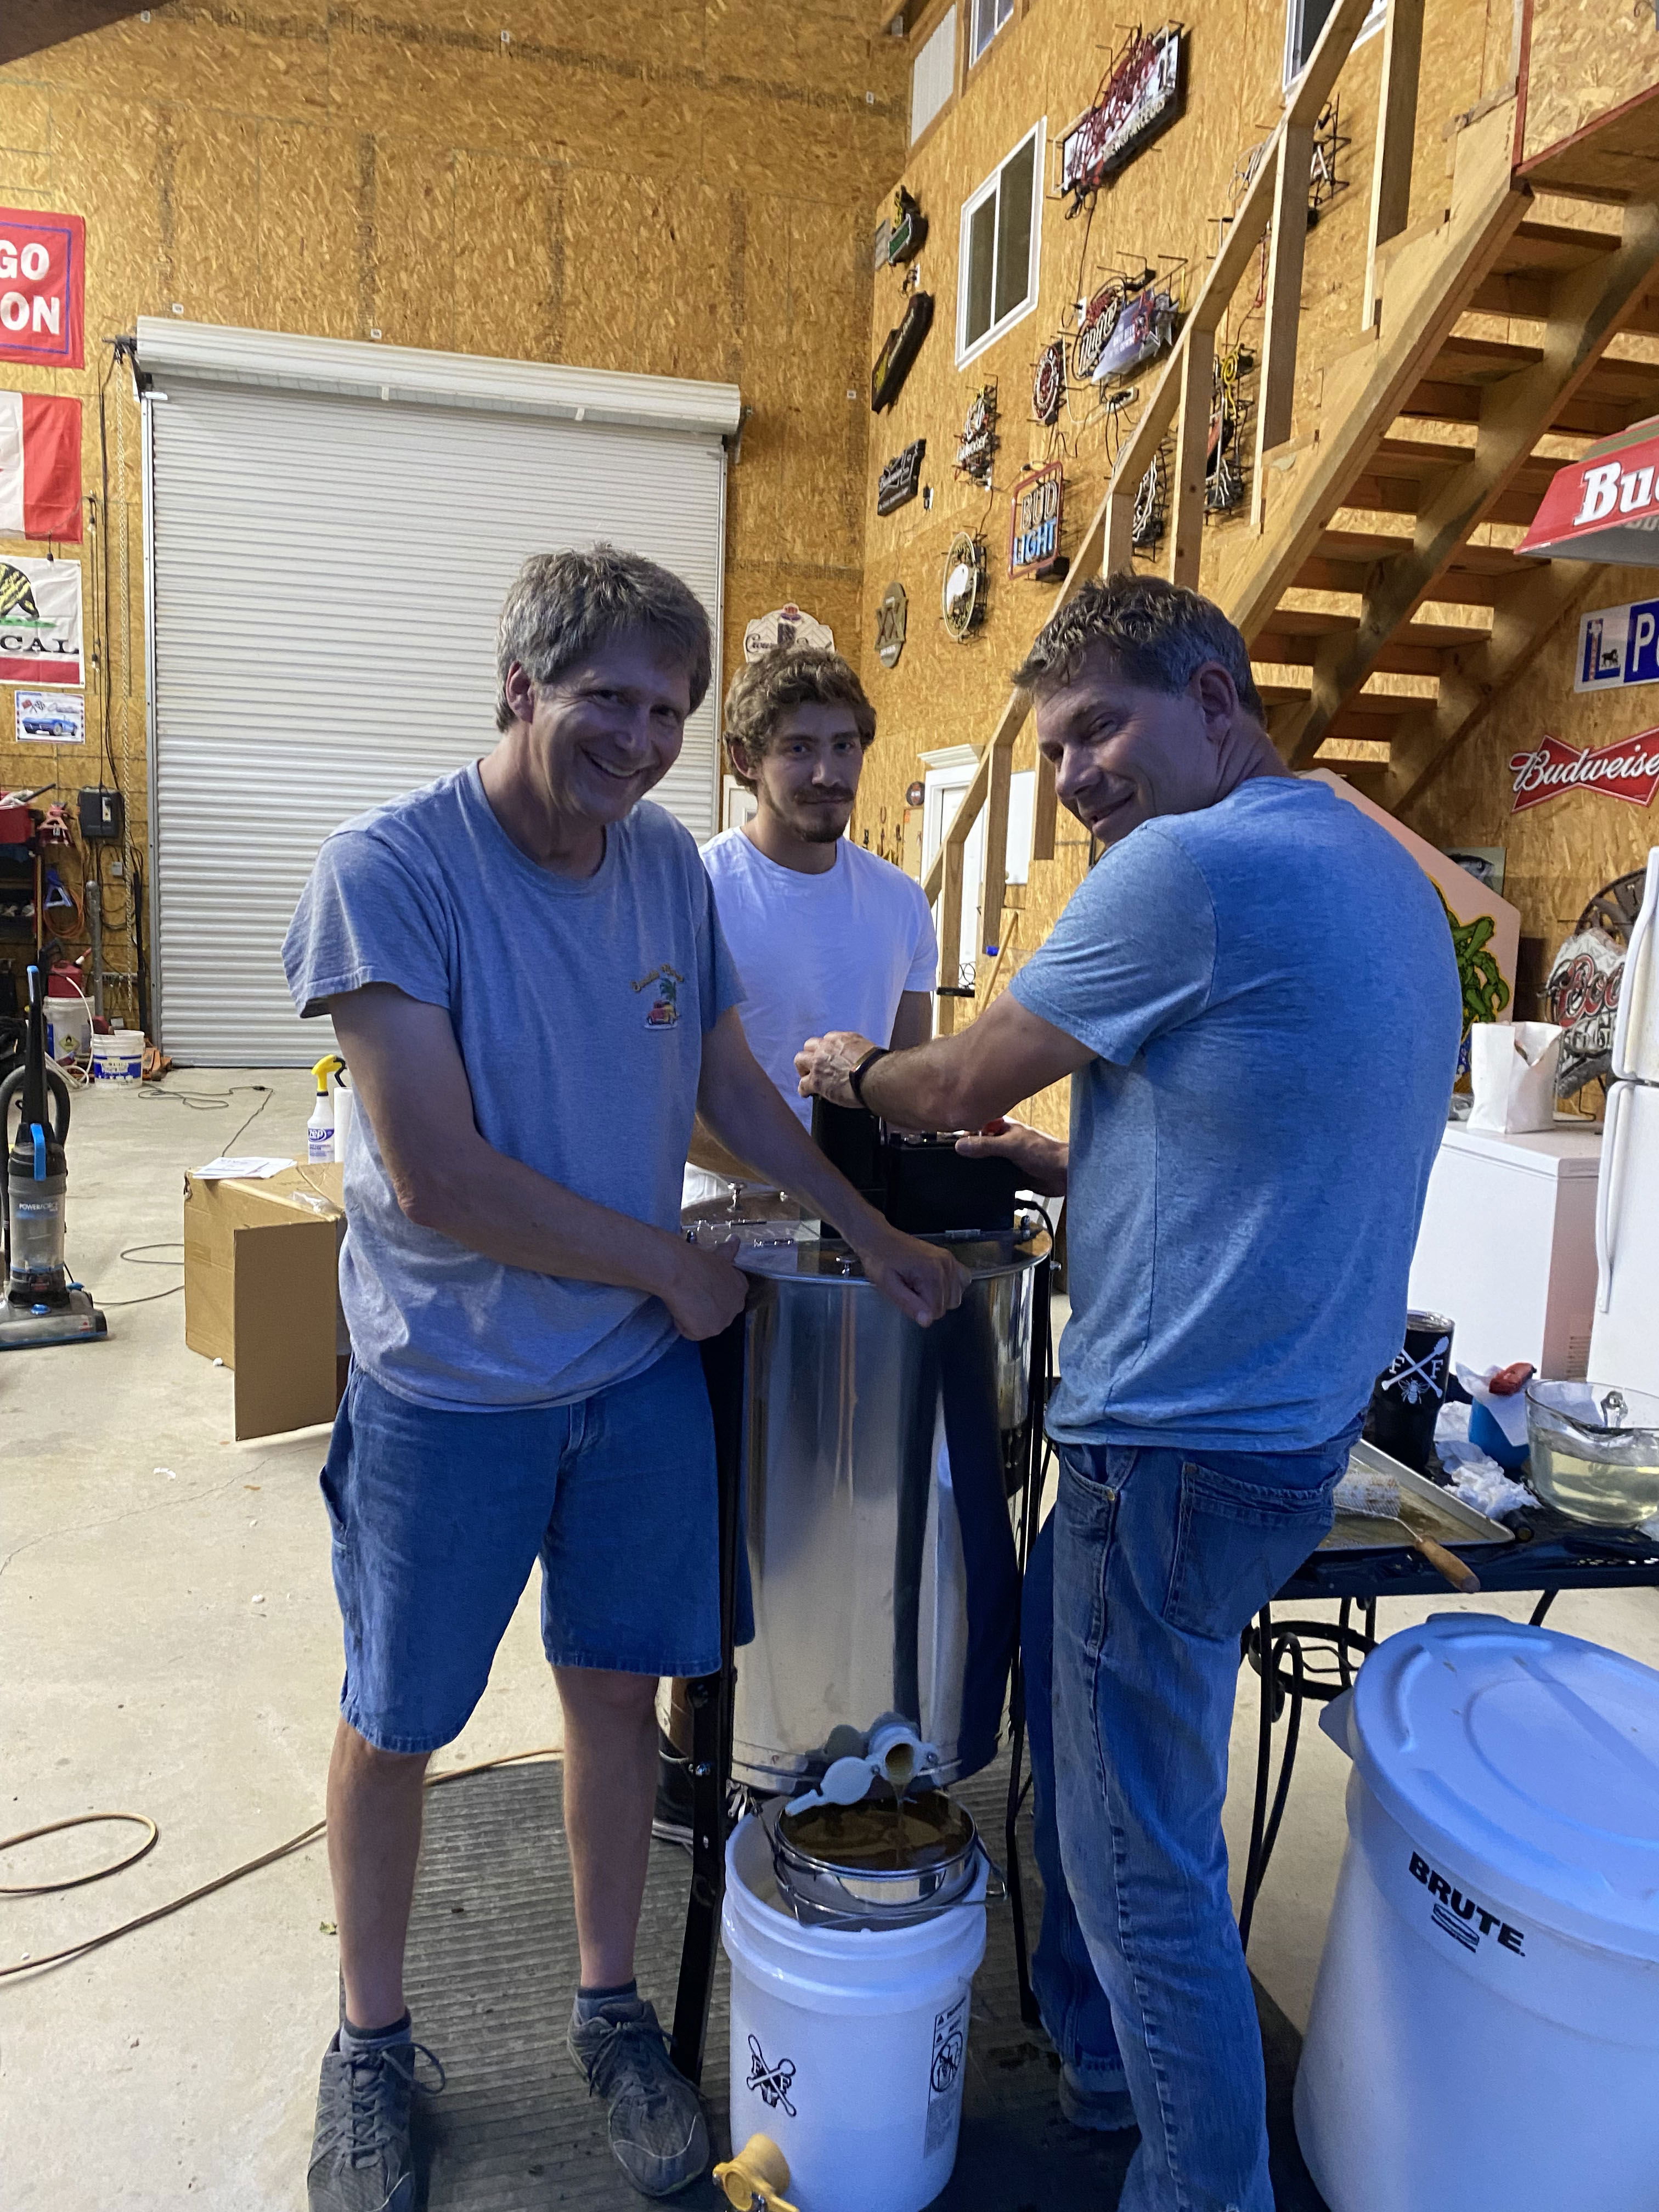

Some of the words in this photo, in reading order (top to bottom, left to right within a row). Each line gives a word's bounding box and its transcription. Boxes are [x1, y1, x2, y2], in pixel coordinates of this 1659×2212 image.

[1020, 479, 1058, 531] BUD
[1573, 461, 1659, 527] Bu
[1013, 516, 1057, 567] LIGHT
[0, 634, 80, 654] CAL
[1633, 613, 1659, 673] P
[1510, 744, 1659, 792] Budweise
